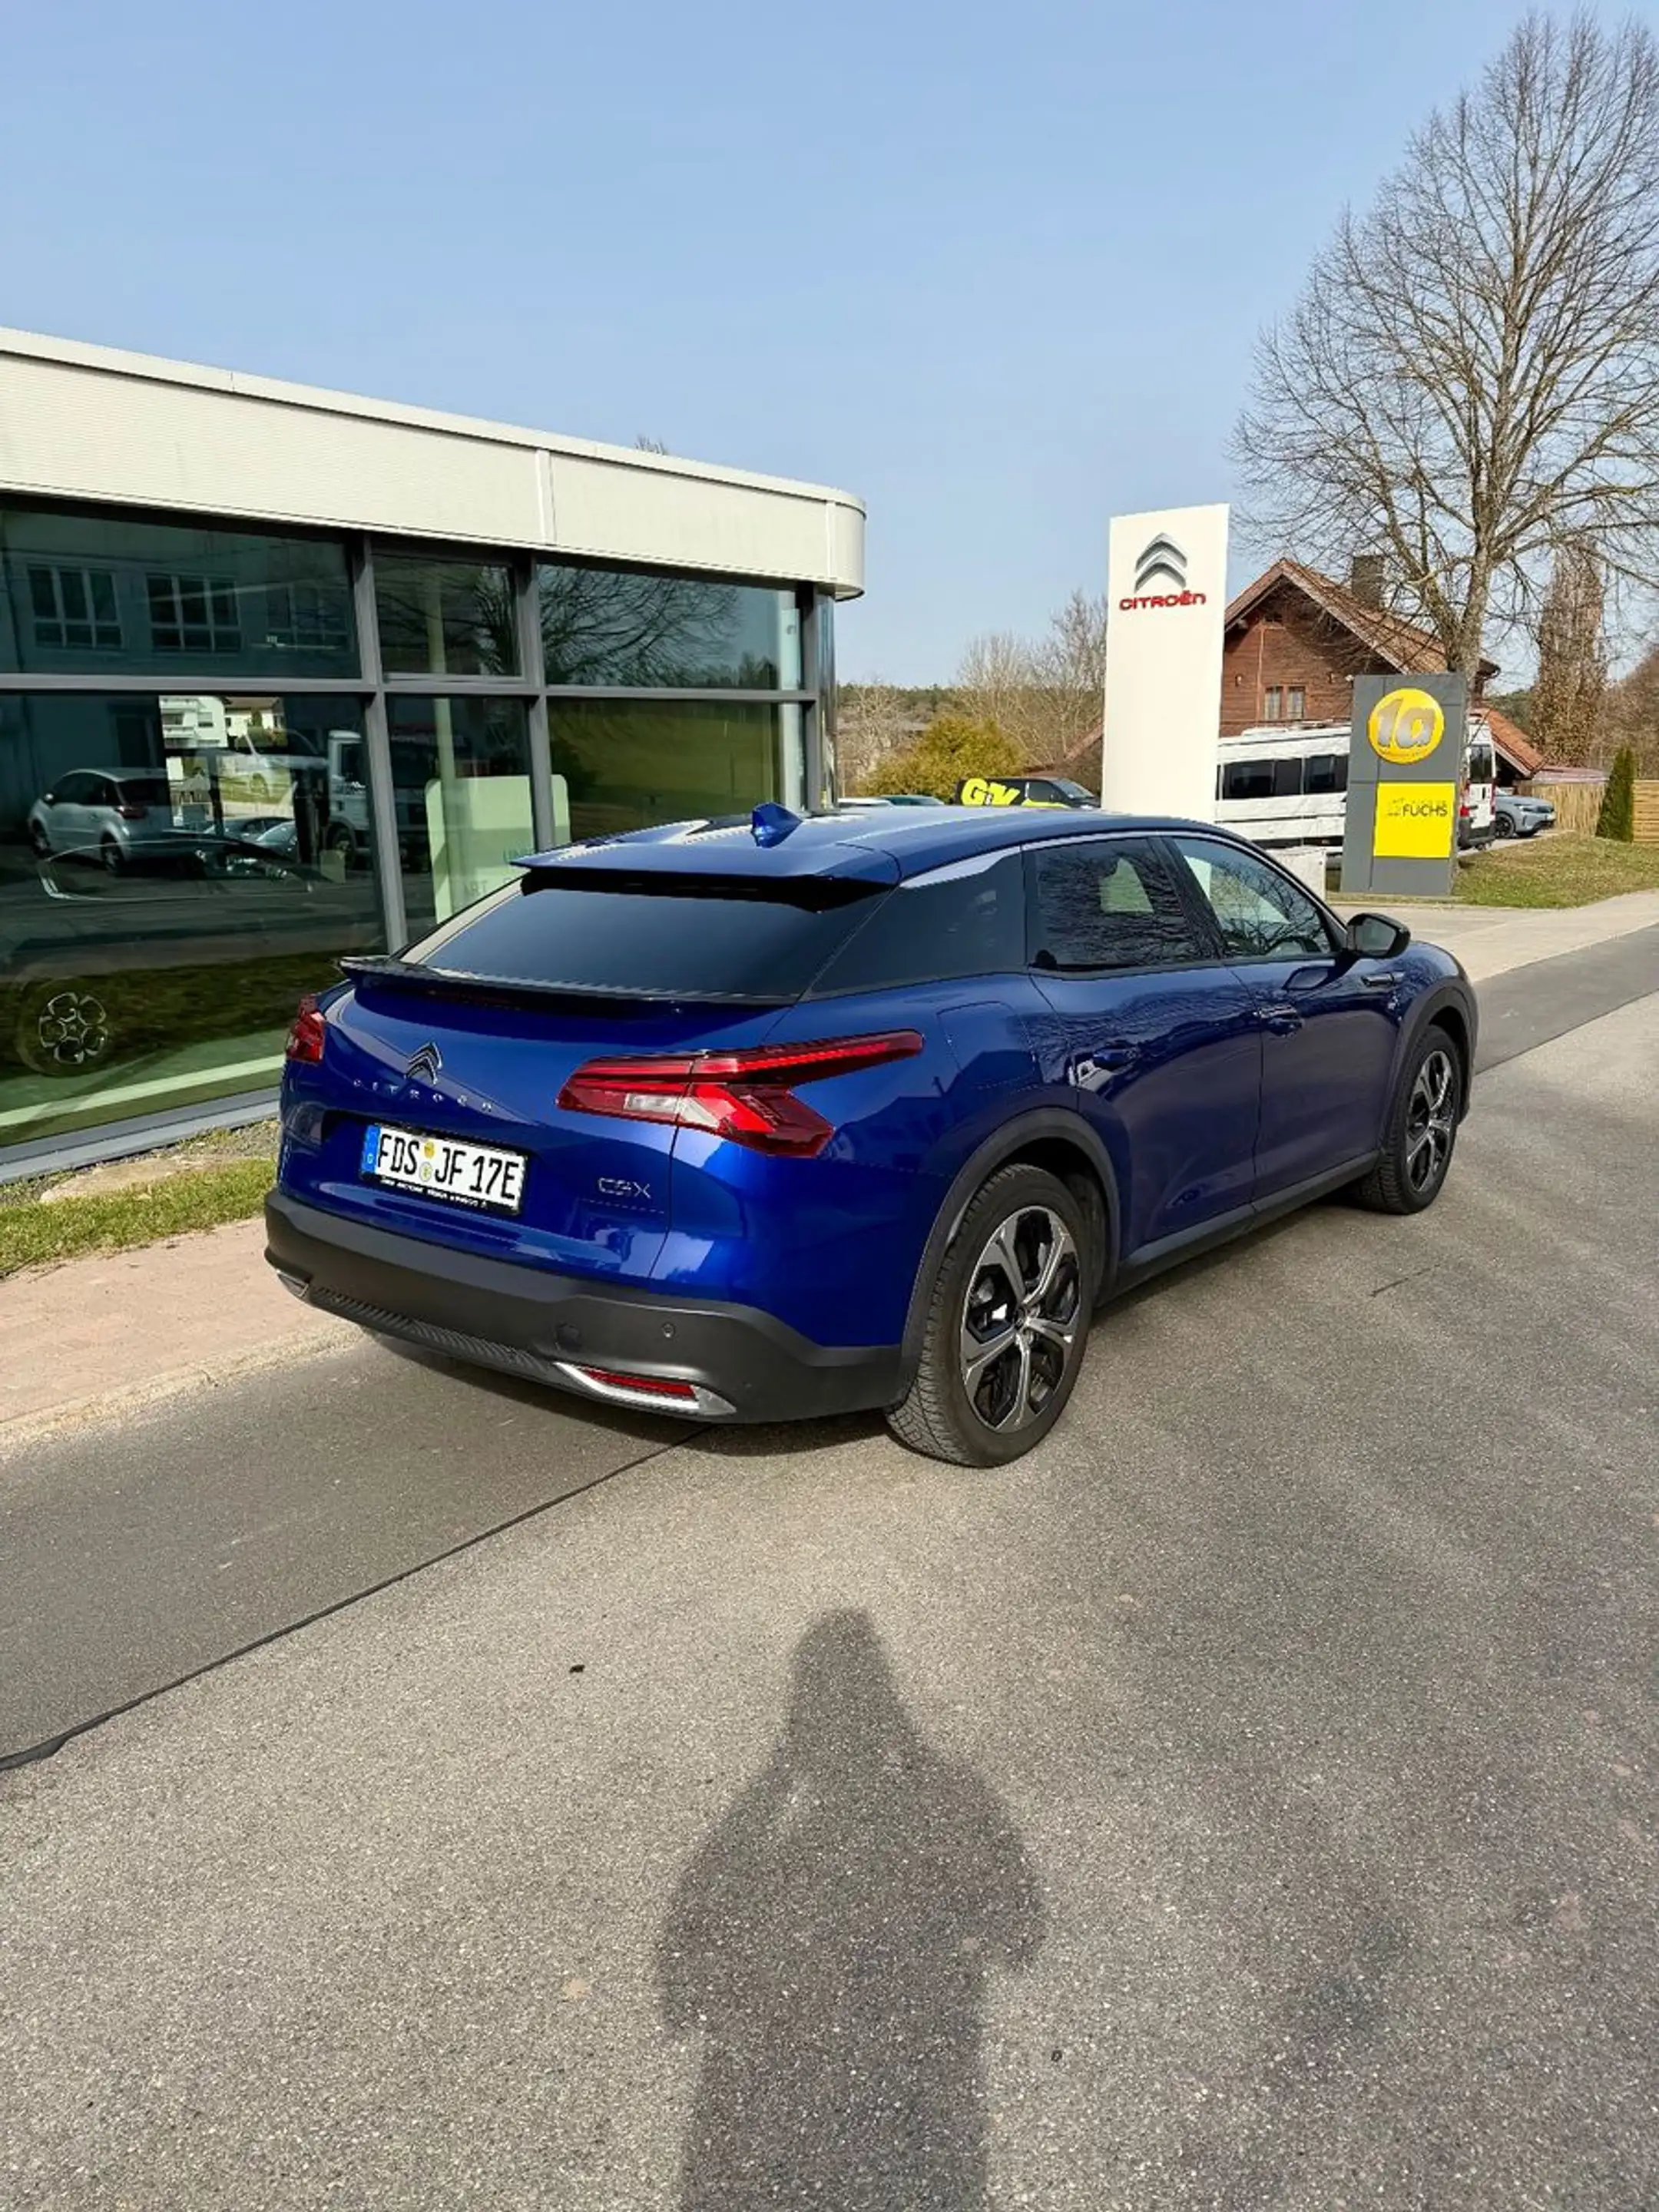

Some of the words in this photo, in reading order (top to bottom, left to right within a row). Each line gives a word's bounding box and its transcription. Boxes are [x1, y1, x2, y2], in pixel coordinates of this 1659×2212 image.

[1402, 804, 1448, 817] FUCHS
[377, 1134, 419, 1175] FDS
[435, 1147, 466, 1185] JF
[469, 1155, 519, 1200] 17E
